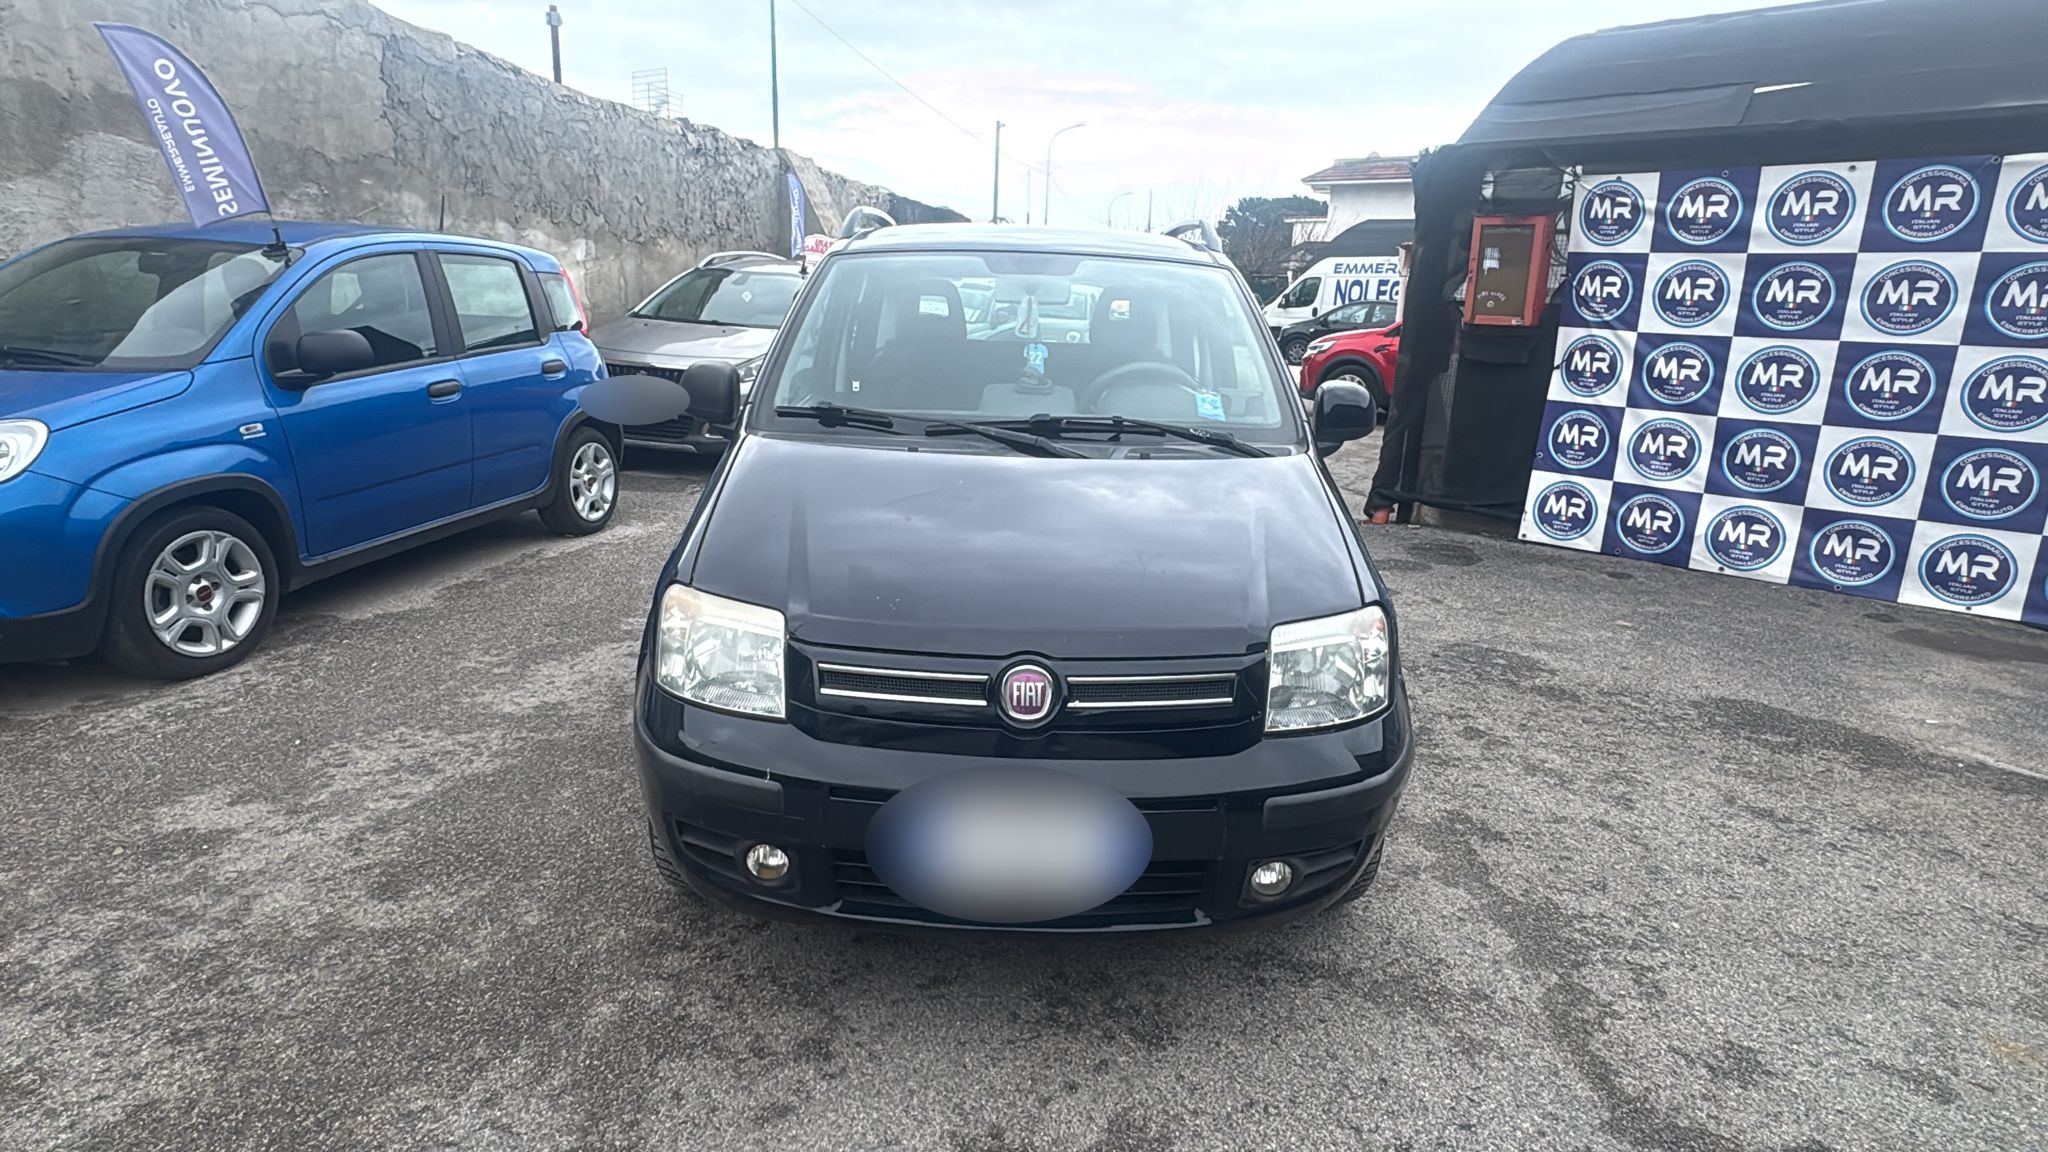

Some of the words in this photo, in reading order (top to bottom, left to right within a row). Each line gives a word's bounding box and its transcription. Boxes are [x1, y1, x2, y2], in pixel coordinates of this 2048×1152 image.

[1901, 170, 1968, 189] CONCESSIONARIA
[1678, 194, 1728, 218] MR
[1781, 190, 1838, 215] MR
[1898, 184, 1962, 211] MR
[2025, 181, 2048, 209] M
[1590, 197, 1631, 219] MR
[1897, 223, 1955, 237] EMMERREAUTO
[1333, 263, 1400, 274] EMMER
[1880, 266, 1945, 283] CONCESSIONARIA
[2005, 267, 2048, 285] CONCESS
[1581, 276, 1620, 298] MR
[1666, 277, 1715, 300] MR
[1765, 279, 1820, 303] MR
[1877, 280, 1939, 305] MR
[1876, 317, 1931, 330] EMMERREAUTO
[2001, 321, 2048, 334] EMMERREA
[1571, 351, 1609, 373] MR
[1653, 357, 1700, 381] MR
[1862, 355, 1925, 373] CONCESSIONARIA
[1750, 363, 1803, 387] MR
[1859, 367, 1920, 393] MR
[1979, 375, 2046, 402] MR
[1859, 403, 1912, 416] EMMERREAUTO
[1978, 413, 2037, 426] EMMERREAUTO
[1558, 423, 1598, 447] MR
[1640, 433, 1687, 457] MR
[1735, 443, 1786, 469] MR
[1842, 442, 1903, 461] CONCESSIONARIA
[1960, 453, 2028, 472] CONCESSIONARIA
[1839, 453, 1898, 480] MR
[1956, 464, 2022, 493] MR
[1545, 494, 1585, 518] MR
[1839, 488, 1890, 501] EMMERREAUTO
[1628, 507, 1672, 532] MR
[1955, 501, 2013, 515] EMMERREAUTO
[1719, 521, 1770, 547] MR
[1826, 524, 1885, 543] CONCESSIONARIA
[1823, 534, 1880, 562] MR
[1939, 540, 2005, 560] CONCESSIONARIA
[1823, 567, 1873, 581] EMMERREAUTO
[1936, 550, 1999, 580] MR
[1935, 585, 1990, 600] EMMERREAUTO
[1013, 682, 1044, 707] FIAT
